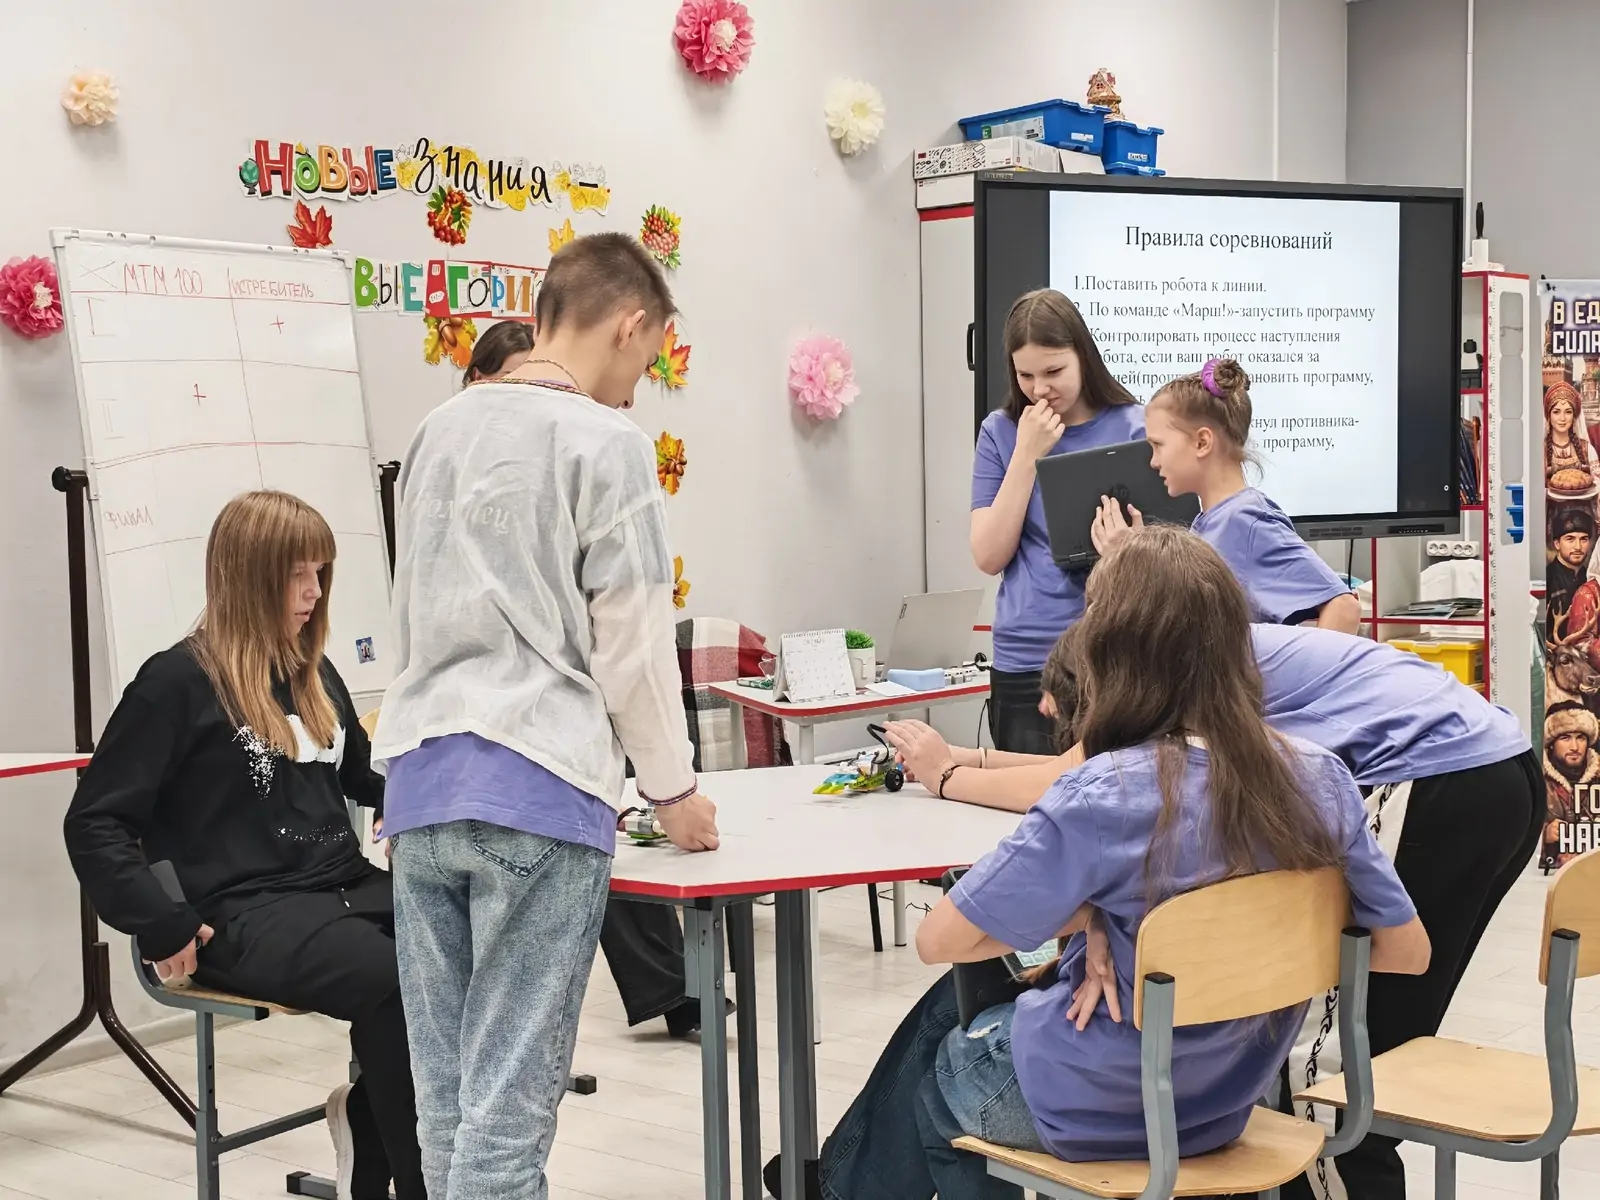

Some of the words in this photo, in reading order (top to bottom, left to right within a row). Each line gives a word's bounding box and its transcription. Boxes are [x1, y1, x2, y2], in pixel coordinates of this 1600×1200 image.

[255, 140, 397, 197] НОВЫЕ
[1125, 225, 1204, 251] Правила
[1209, 231, 1333, 253] соревнований
[123, 262, 168, 296] МТМ
[174, 267, 203, 295] 100
[354, 257, 424, 312] ВЫЕ
[447, 264, 543, 313] ГОРИ
[1161, 276, 1207, 295] робота
[1211, 281, 1219, 292] к
[1222, 281, 1267, 293] линии.
[1089, 301, 1109, 317] По
[1113, 306, 1169, 319] команде
[1307, 307, 1376, 322] программу
[1553, 301, 1565, 325] В
[1575, 301, 1600, 325] ЕД
[1089, 327, 1200, 346] Контролировать
[1203, 331, 1257, 346] процесс
[1261, 331, 1341, 346] наступления
[1103, 348, 1138, 365] бота,
[1141, 352, 1172, 364] если
[1177, 352, 1203, 363] ваш
[1248, 351, 1305, 364] оказался
[1307, 352, 1321, 363] за
[1249, 371, 1299, 384] ановить
[1303, 371, 1374, 387] программу,
[1263, 437, 1335, 452] программу,
[1574, 784, 1600, 814] ГО
